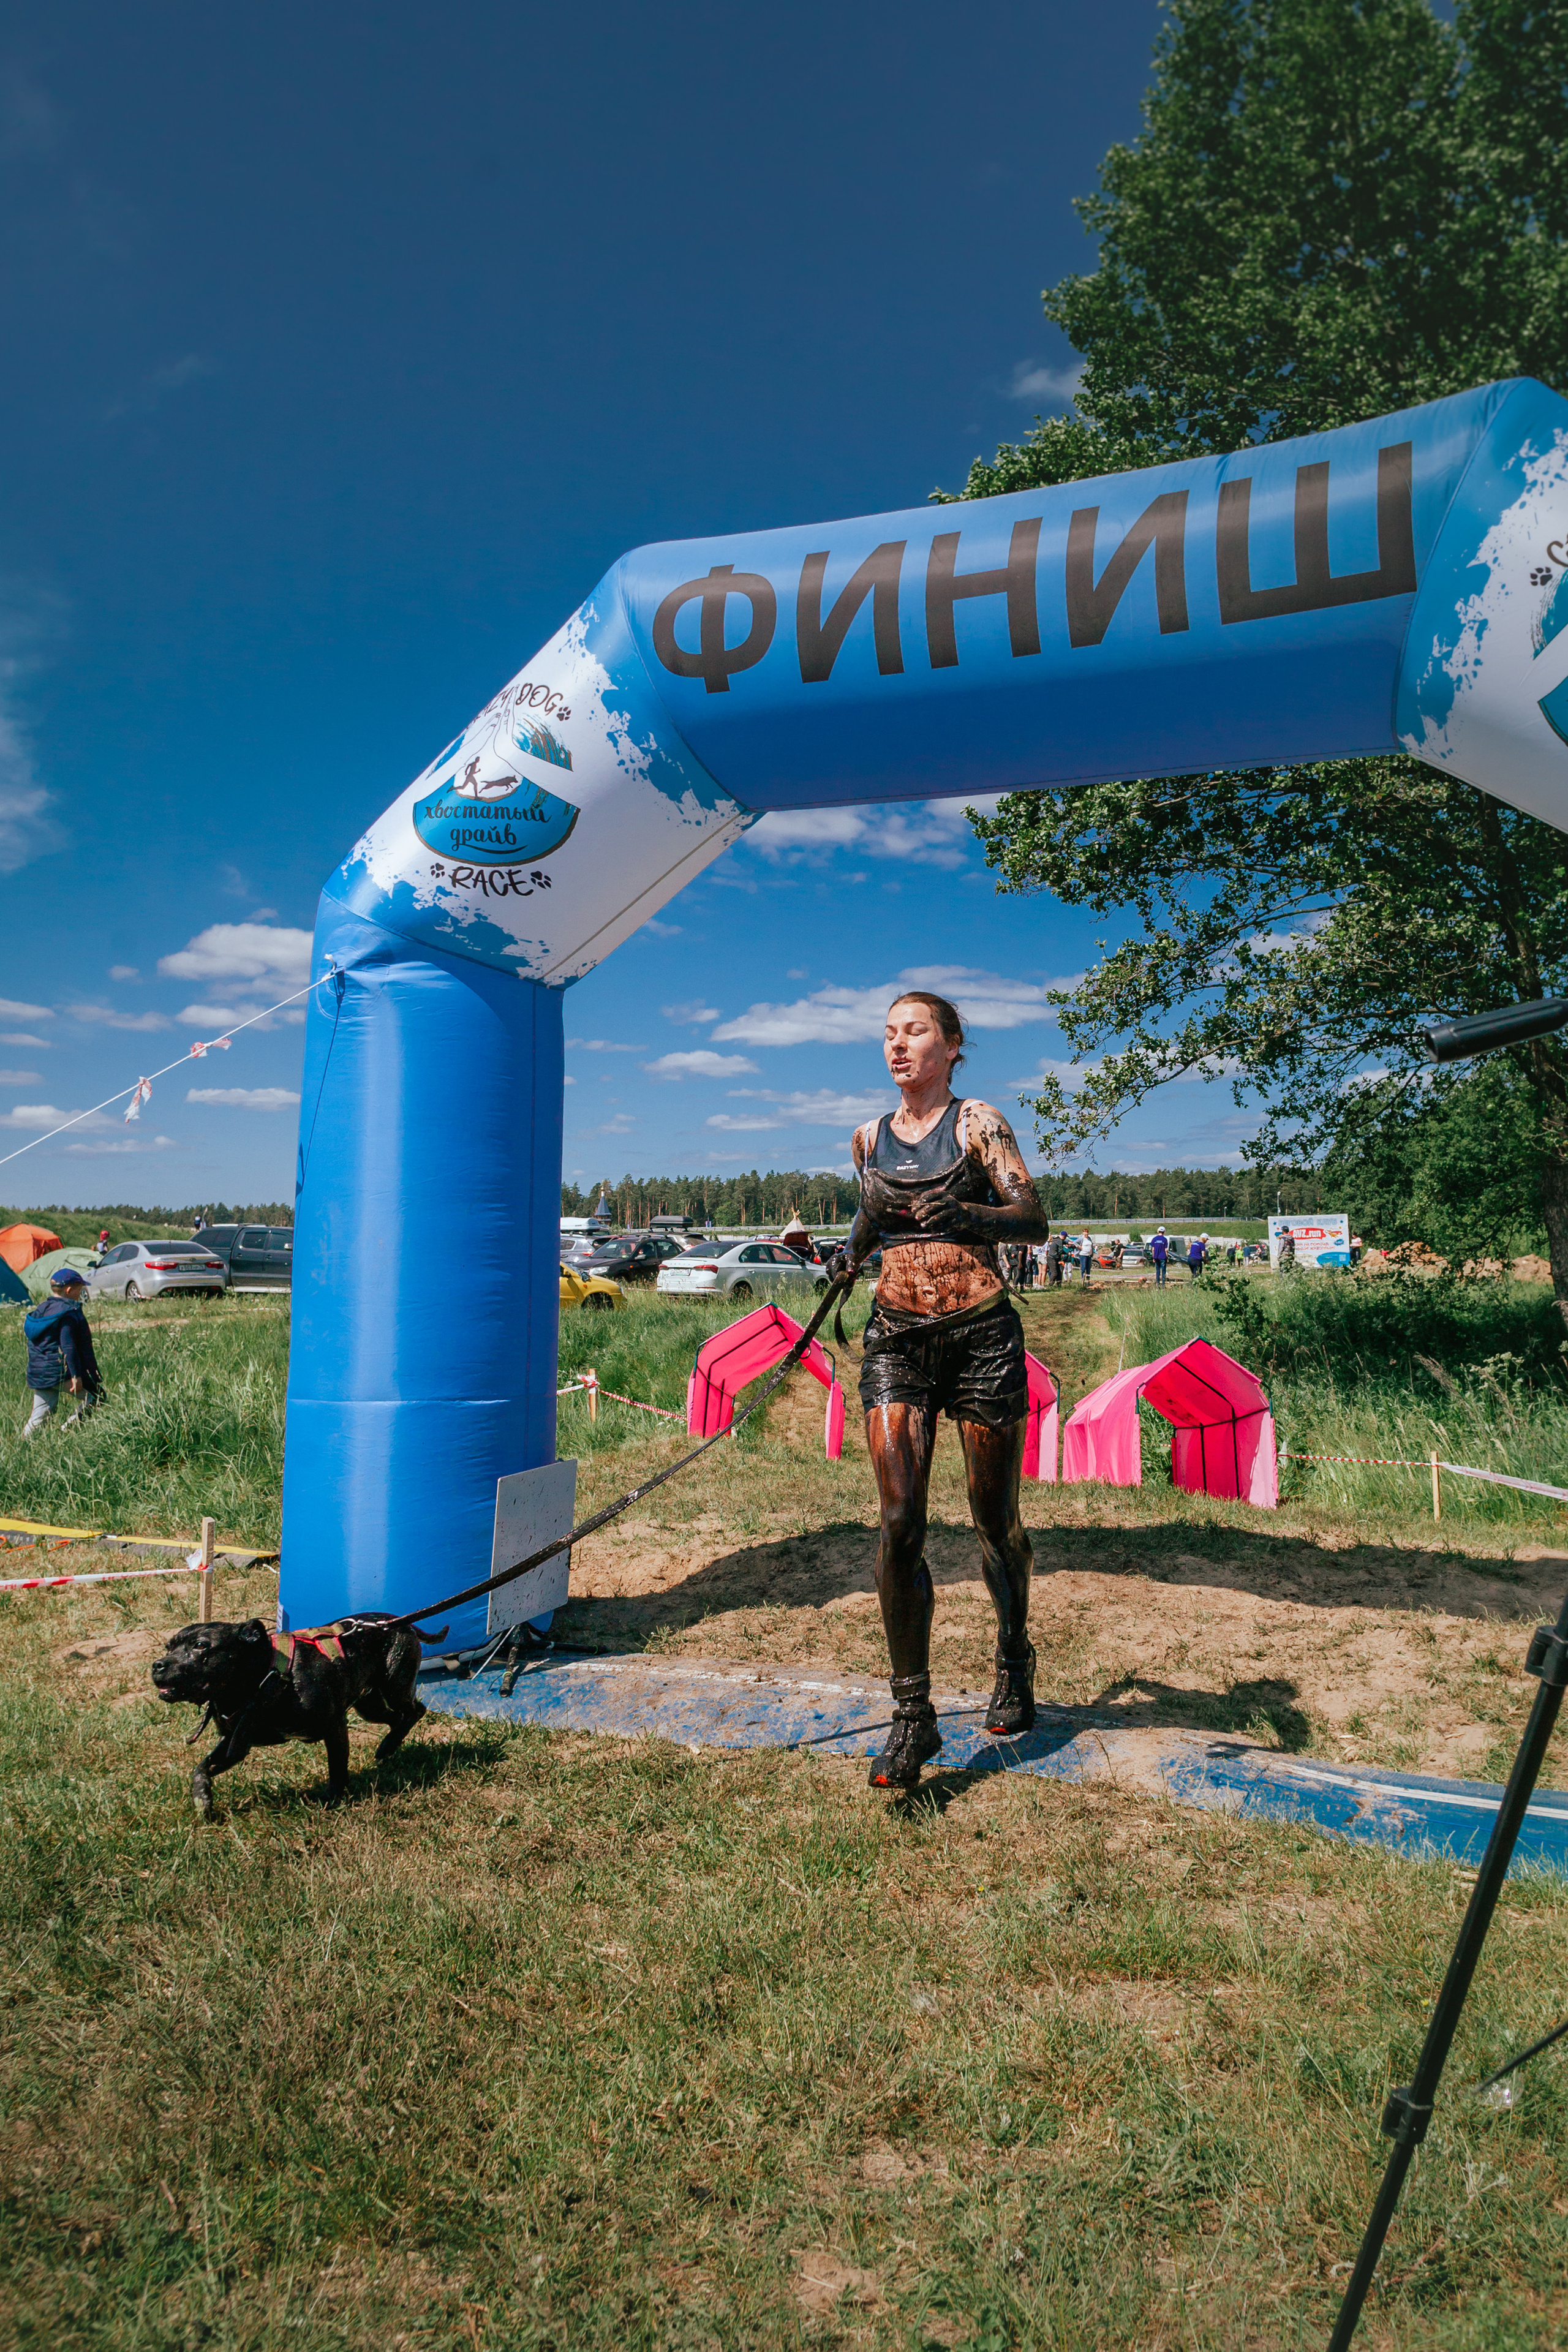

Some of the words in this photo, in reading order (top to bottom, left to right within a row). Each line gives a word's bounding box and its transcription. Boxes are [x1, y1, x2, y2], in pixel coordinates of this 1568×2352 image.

[652, 440, 1417, 694] ФИНИШ
[515, 682, 564, 716] DOG
[424, 799, 552, 823] хвостатый
[450, 823, 517, 851] драйв
[448, 865, 534, 897] RACE
